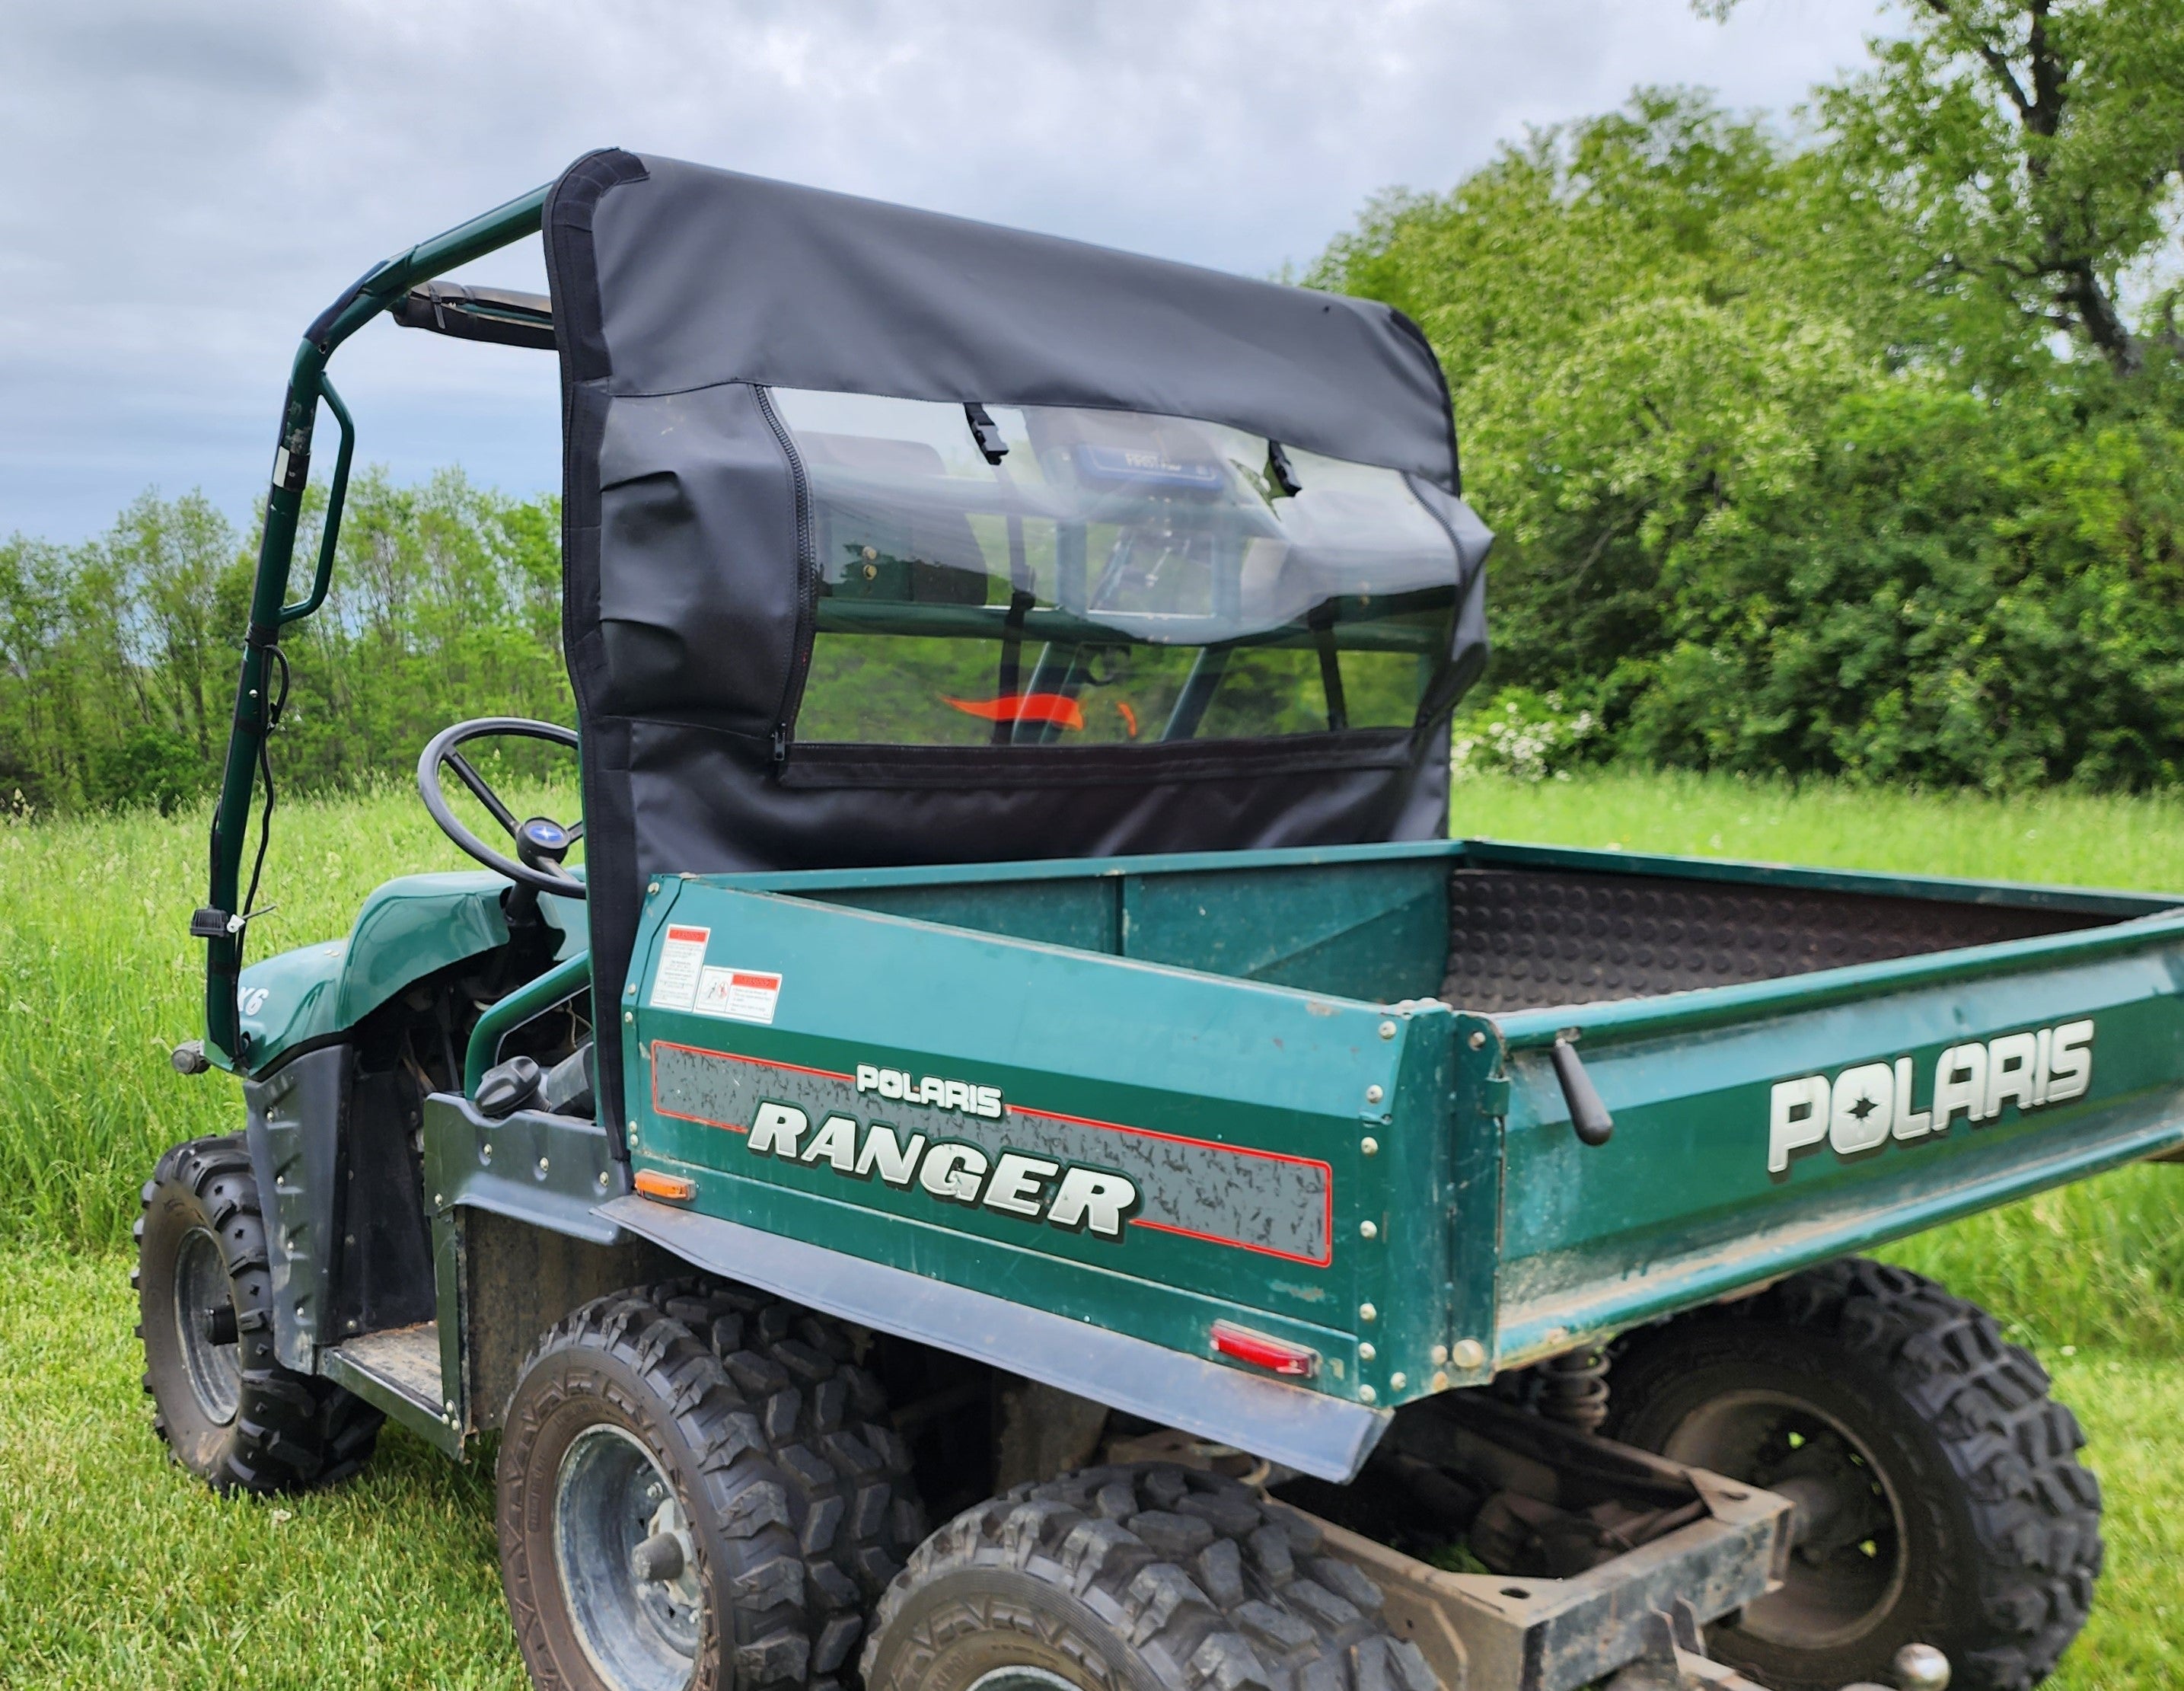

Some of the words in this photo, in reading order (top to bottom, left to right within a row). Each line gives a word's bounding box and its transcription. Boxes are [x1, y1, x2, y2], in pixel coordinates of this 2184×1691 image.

[856, 1063, 1003, 1118] POLARIS
[1768, 1019, 2095, 1173] POLARIS
[747, 1101, 1137, 1236] RANGER
